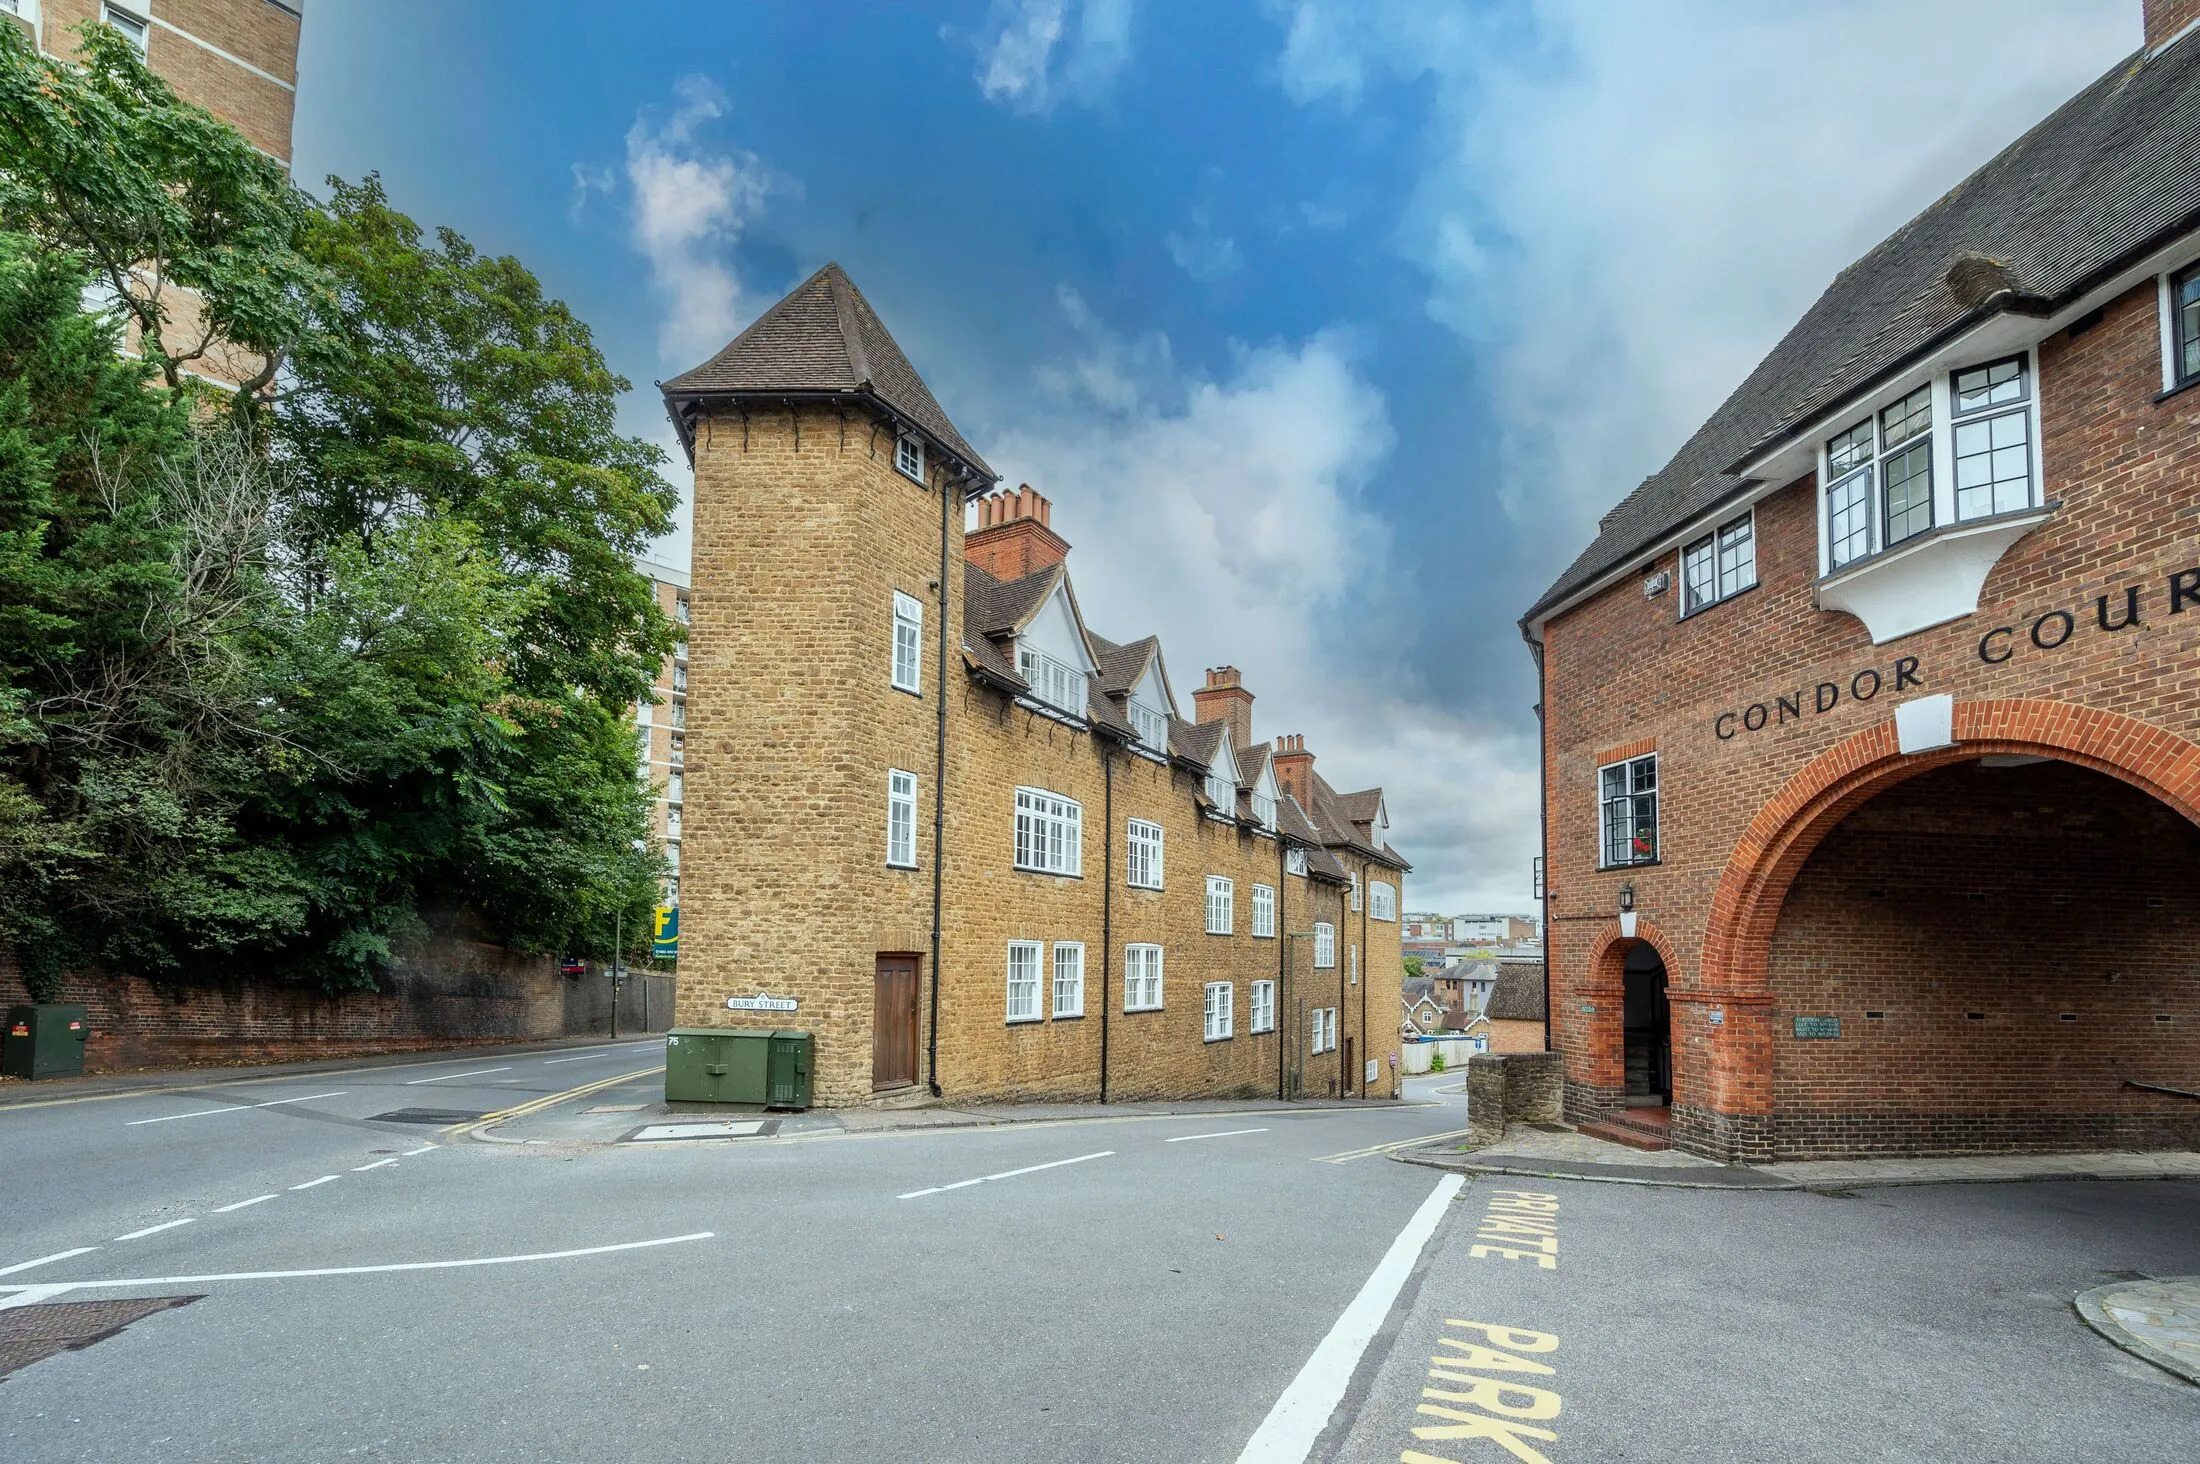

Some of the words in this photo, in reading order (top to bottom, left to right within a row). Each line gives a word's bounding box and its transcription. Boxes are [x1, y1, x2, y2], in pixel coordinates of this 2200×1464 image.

[1715, 655, 1924, 740] CONDOR
[732, 1000, 755, 1008] BURY
[758, 1001, 792, 1009] STREET
[668, 1037, 679, 1046] 75
[1470, 1190, 1560, 1270] PRIVATE
